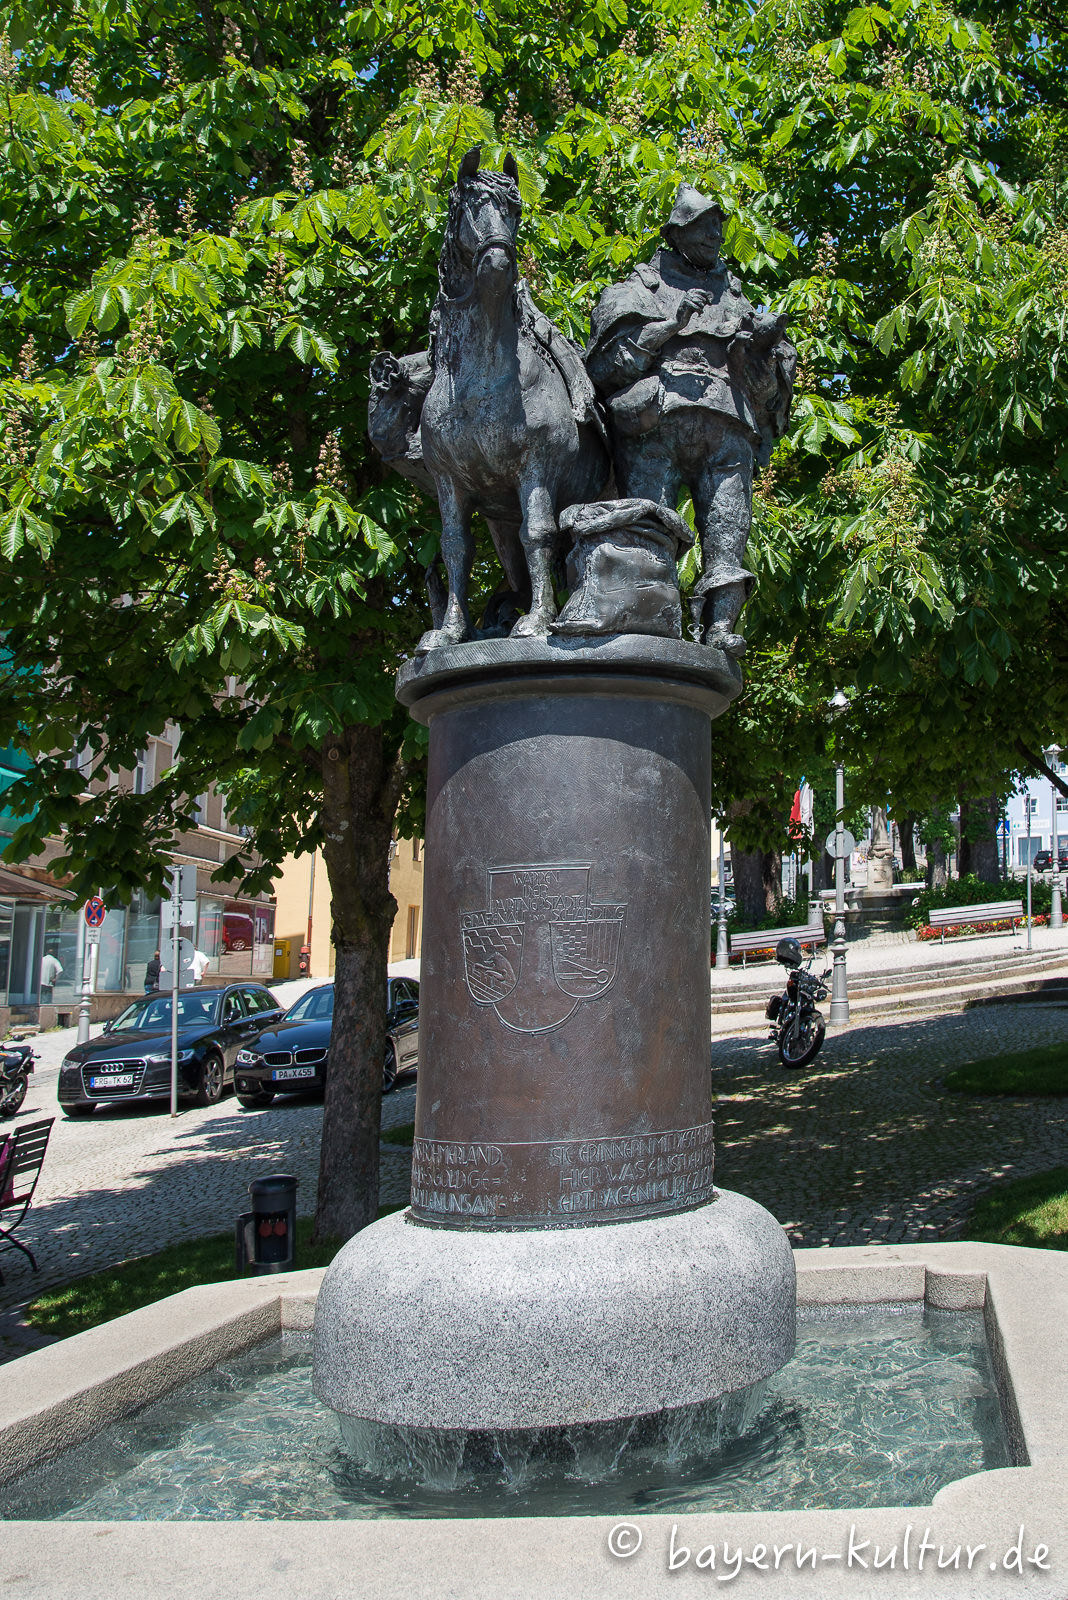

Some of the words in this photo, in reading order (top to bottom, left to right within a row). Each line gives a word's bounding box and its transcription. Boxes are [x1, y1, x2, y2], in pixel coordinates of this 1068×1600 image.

[513, 870, 560, 886] WAPPEN
[523, 884, 549, 898] DER
[559, 1165, 601, 1189] HIER
[605, 1159, 646, 1182] WAS
